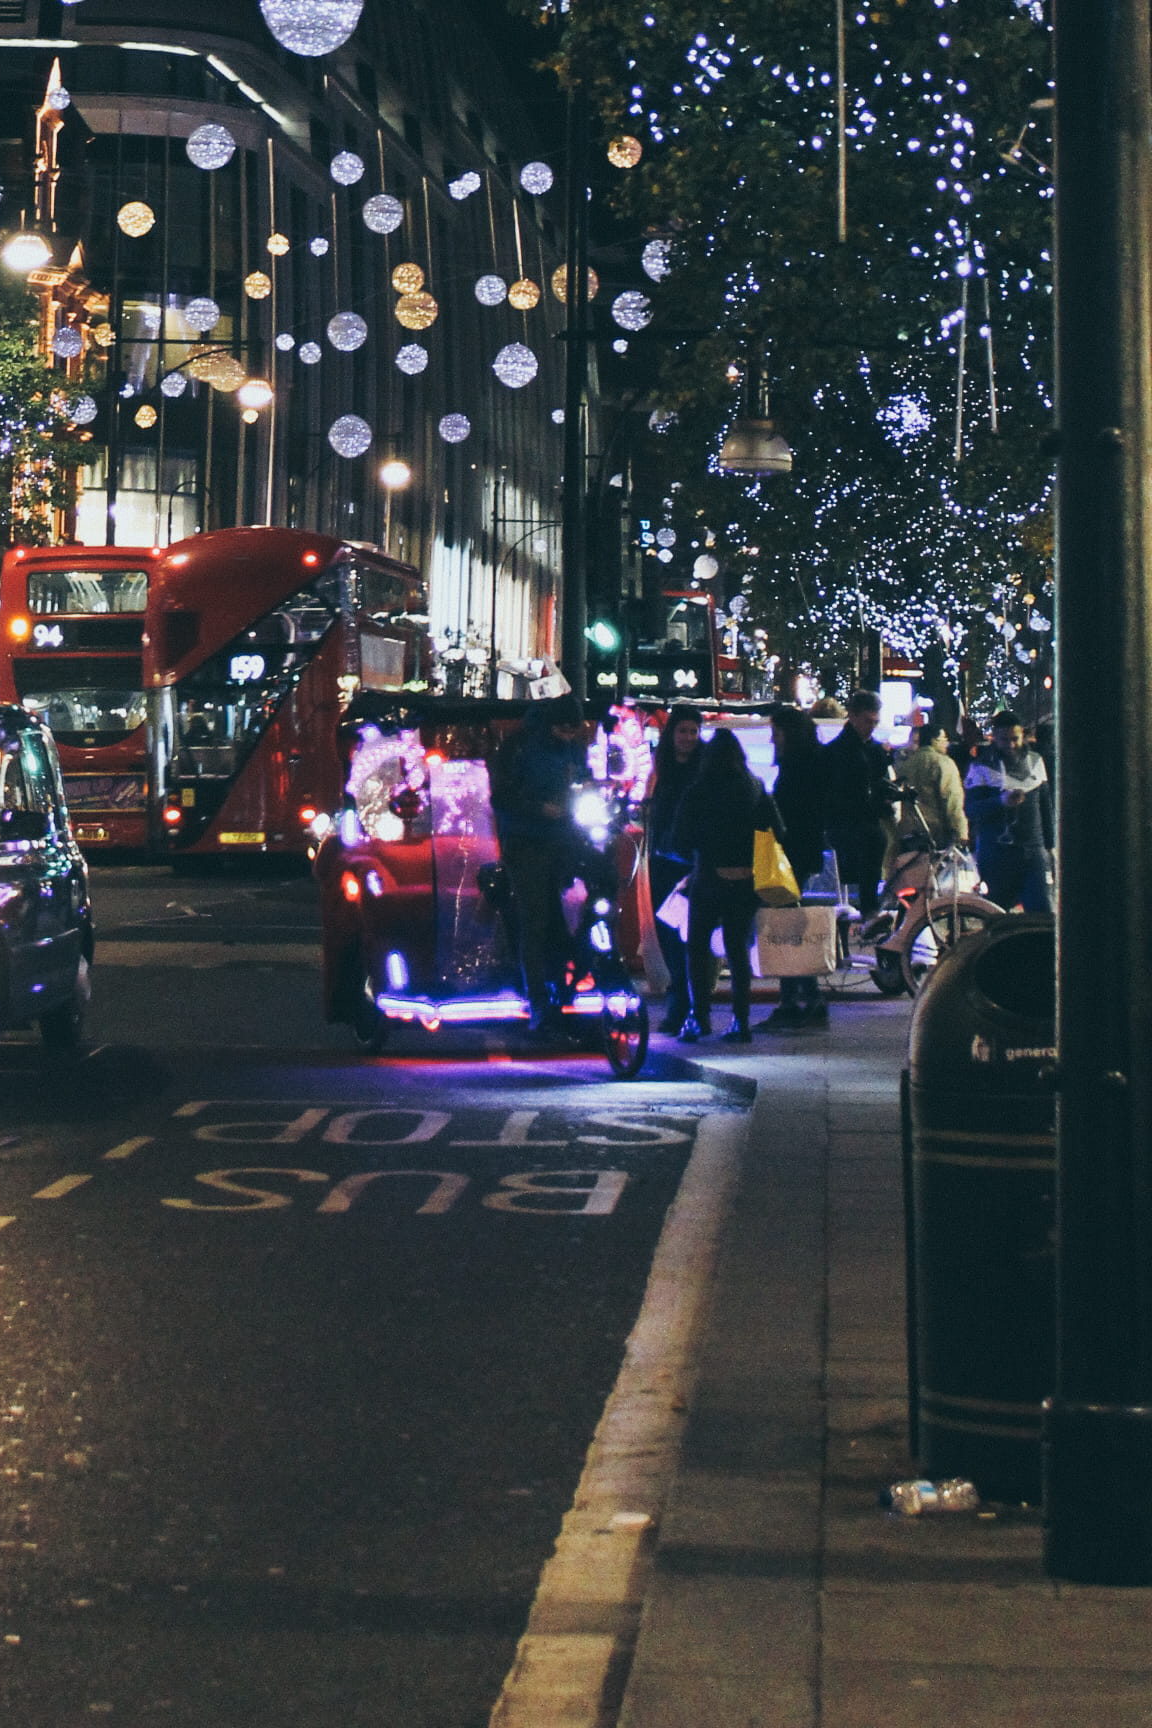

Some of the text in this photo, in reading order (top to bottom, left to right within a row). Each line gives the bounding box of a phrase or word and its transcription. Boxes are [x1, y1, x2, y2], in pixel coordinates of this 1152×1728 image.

[33, 624, 64, 647] 94
[230, 655, 265, 680] 159
[673, 669, 698, 688] 94
[1006, 1047, 1057, 1061] genera
[194, 1108, 702, 1146] STOP
[160, 1168, 629, 1215] BUS
